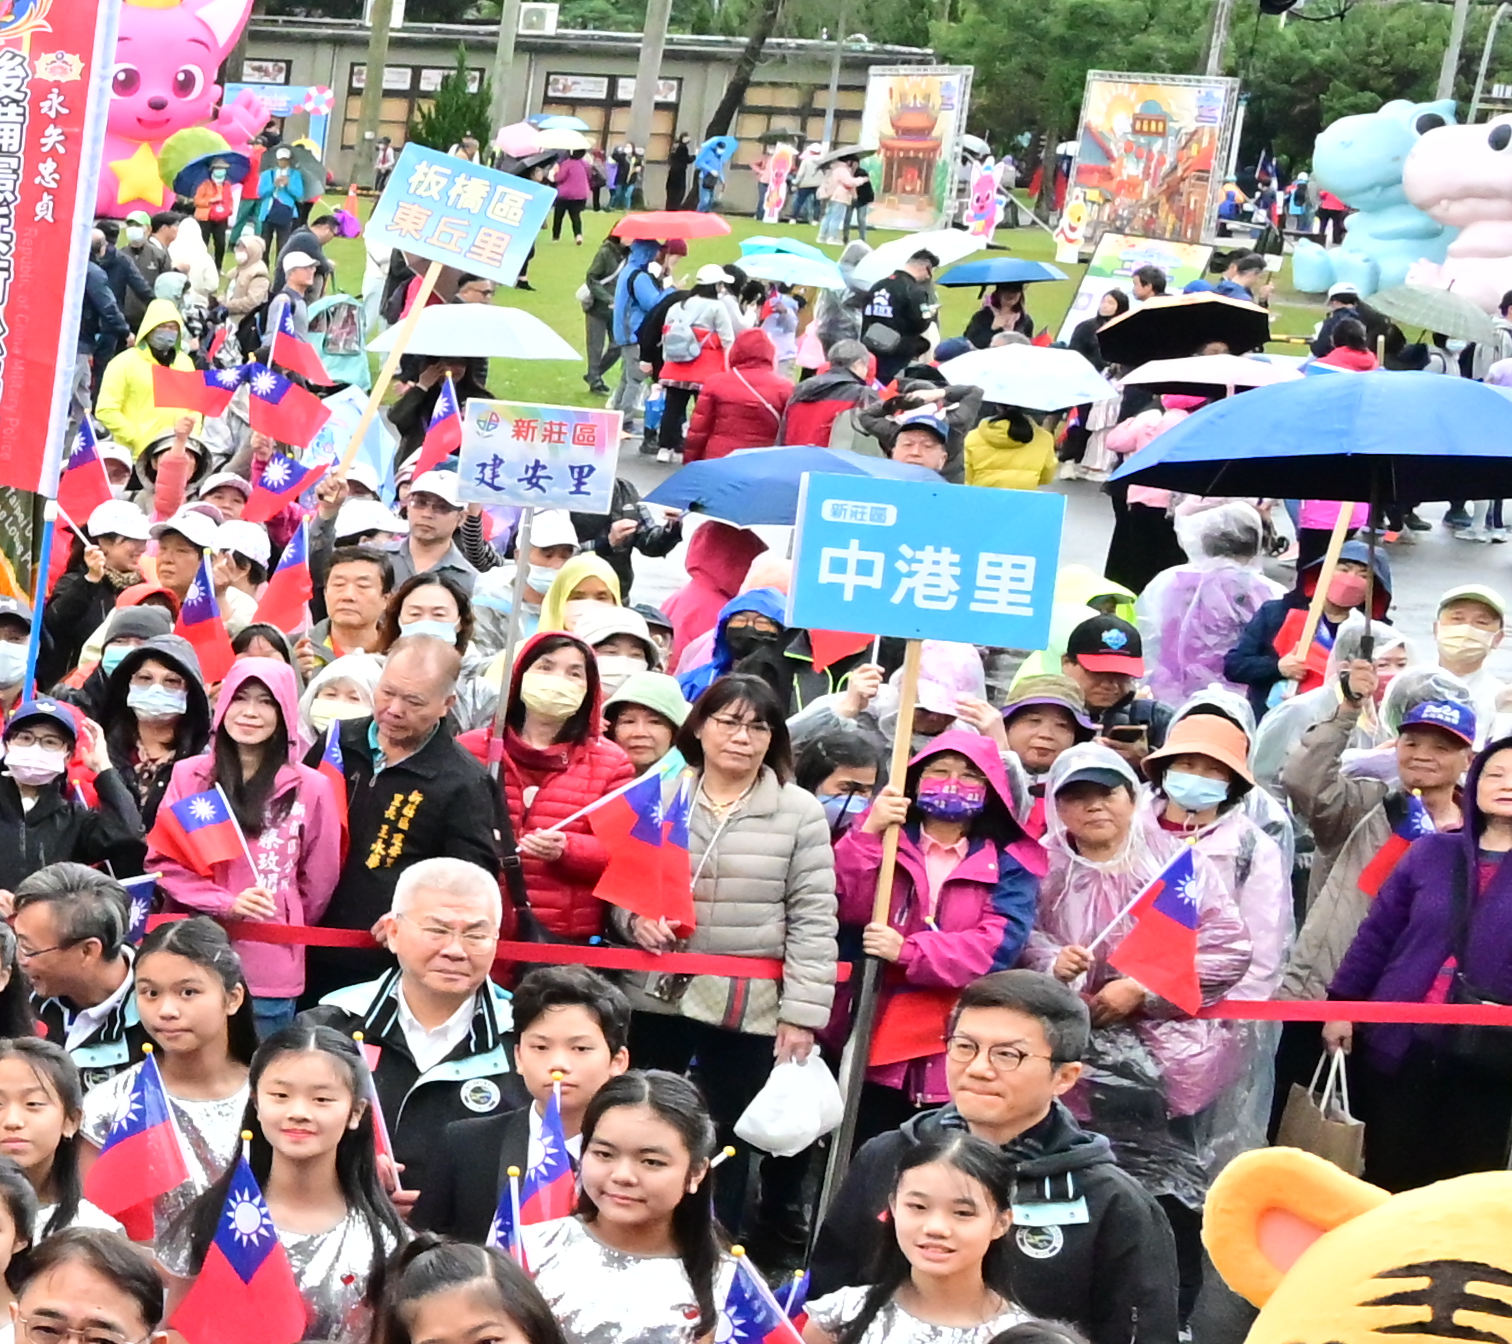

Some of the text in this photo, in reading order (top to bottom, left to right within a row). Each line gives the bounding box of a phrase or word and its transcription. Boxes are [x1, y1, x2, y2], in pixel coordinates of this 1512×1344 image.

[34, 88, 70, 224] 永矢忠貞
[407, 160, 533, 228] 板橋區
[386, 202, 512, 268] 東丘里
[512, 418, 599, 447] 新莊區
[475, 454, 596, 496] 建安里
[817, 539, 1035, 616] 中港里
